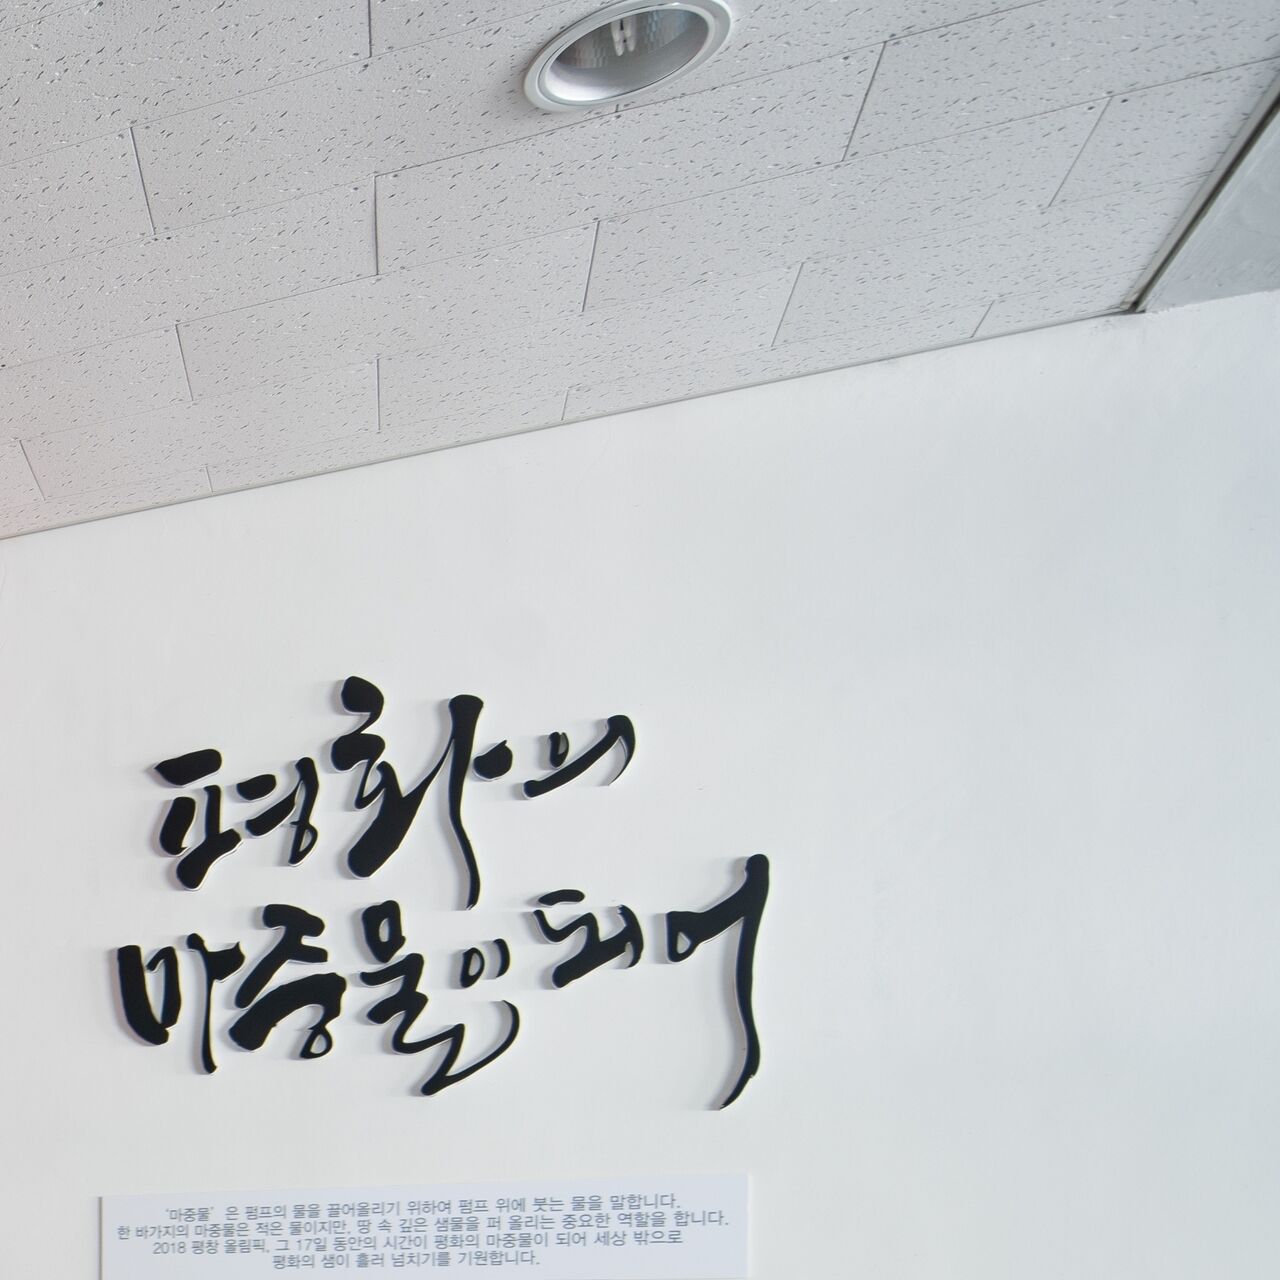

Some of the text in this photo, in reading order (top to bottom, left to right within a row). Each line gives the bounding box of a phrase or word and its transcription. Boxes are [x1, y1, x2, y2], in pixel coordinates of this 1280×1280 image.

[155, 675, 636, 909] 평화의
[533, 854, 770, 1110] 되어
[225, 1206, 240, 1221] 은
[245, 1204, 287, 1220] 펌프의
[291, 1203, 320, 1219] 물을
[327, 1201, 401, 1218] 끌어올리기
[407, 1199, 451, 1215] 위하여
[458, 1198, 489, 1213] 펌프
[495, 1198, 526, 1213] 위에
[532, 1196, 564, 1213] 붓는
[571, 1195, 603, 1211] 물을
[610, 1193, 681, 1210] 말합니다.
[117, 1225, 130, 1240] 한
[135, 1224, 189, 1239] 바가지의
[194, 1223, 248, 1239] 마중물은
[255, 1221, 284, 1237] 적은
[357, 1219, 371, 1235] 땅
[378, 1218, 393, 1234] 속
[399, 1217, 428, 1233] 깊은
[434, 1215, 479, 1232] 샘물을
[487, 1216, 501, 1231] 퍼
[507, 1214, 555, 1231] 올리는
[561, 1213, 610, 1230] 중요한
[618, 1211, 667, 1228] 역할을
[673, 1210, 729, 1227] 합니다.
[152, 1241, 187, 1255] 2018
[191, 1239, 219, 1255] 평창
[275, 1239, 290, 1252] 그
[296, 1237, 327, 1252] 17일
[332, 1235, 377, 1251] 동안의
[383, 1234, 427, 1250] 시간이
[434, 1232, 479, 1249] 평화의
[486, 1231, 549, 1249] 마중물이
[556, 1231, 587, 1247] 되어
[593, 1230, 627, 1247] 세상
[634, 1229, 683, 1245] 밖으로
[272, 1249, 541, 1269] 평화의 샘이 흘러 넘치기를 기원합니다.
